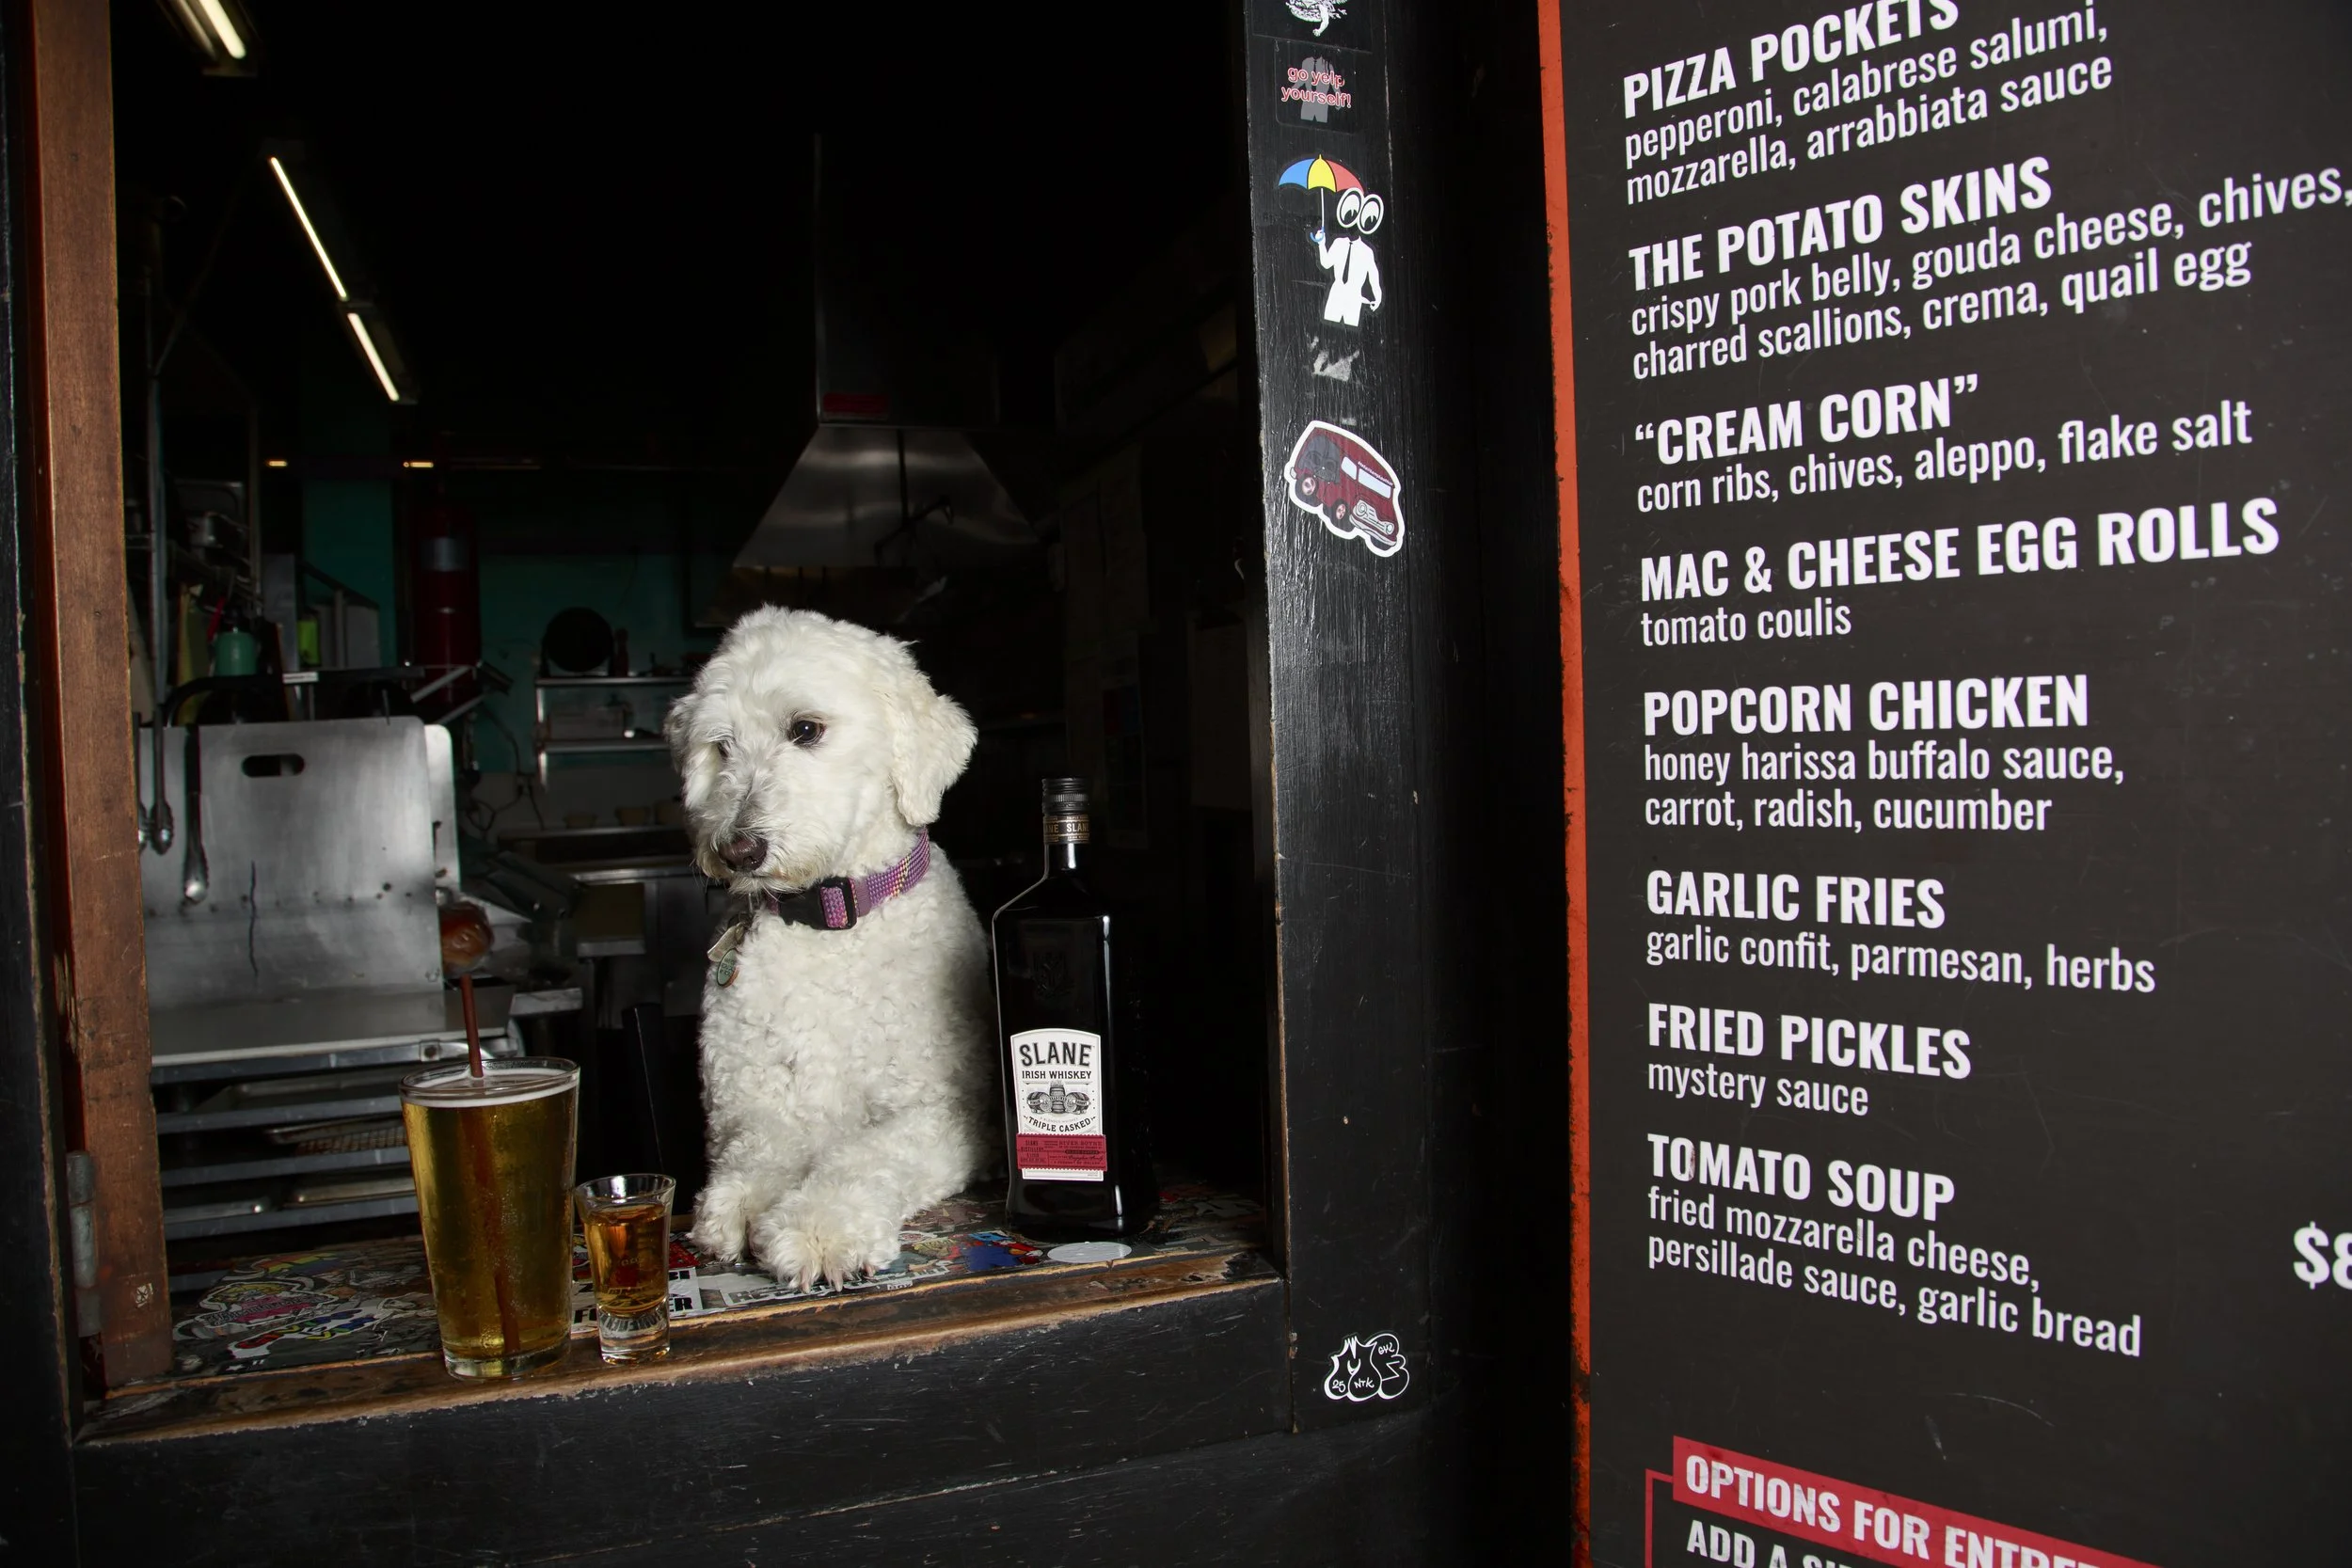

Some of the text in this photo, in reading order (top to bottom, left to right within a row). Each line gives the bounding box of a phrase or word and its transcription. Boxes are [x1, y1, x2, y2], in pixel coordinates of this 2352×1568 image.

[1287, 67, 1345, 89] go yelp
[1623, 0, 1959, 119] PIZZA POCKETS
[1625, 0, 2107, 170] pepperoni, calabrese salumi,
[1281, 87, 1352, 108] yourself!
[1627, 56, 2112, 205] mozzarella, arrabbiata sauce
[1628, 156, 2052, 292] THE POTATO SKINS
[1631, 167, 2352, 336] crispy pork belly, gouda cheese, chives,
[1633, 241, 2252, 380] charred scallions, crema, quail egg
[1637, 399, 2253, 513] corn ribs, chives, aleppo, flake salt
[1641, 497, 2280, 602] MAC & CHEESE EGG ROLLS
[1640, 596, 1851, 647] tomato coulis
[1644, 673, 2088, 736] POPCORN CHICKEN
[1645, 737, 2123, 786] honey harissa buffalo sauce,
[1645, 787, 2053, 834] carrot, radish, cucumber
[1646, 869, 1946, 929] GARLIC FRIES
[1645, 924, 2155, 993] garlic confit, parmesan, herbs
[1019, 1041, 1092, 1067] SLANE
[1022, 1070, 1092, 1080] IRISH WHISKEY
[1648, 1003, 1971, 1080] FRIED PICKLES
[1028, 1116, 1091, 1132] TRIPLE CASKED
[1648, 1063, 1868, 1117] mystery sauce
[1647, 1132, 1955, 1222] TOMATO SOUP
[1647, 1185, 2039, 1293] fried mozzarella cheese,
[1648, 1235, 2141, 1357] persillade sauce, garlic bread
[1686, 1454, 1841, 1533] OPTIONS
[1853, 1499, 1931, 1560] FOR
[1686, 1519, 1788, 1568] ADD A
